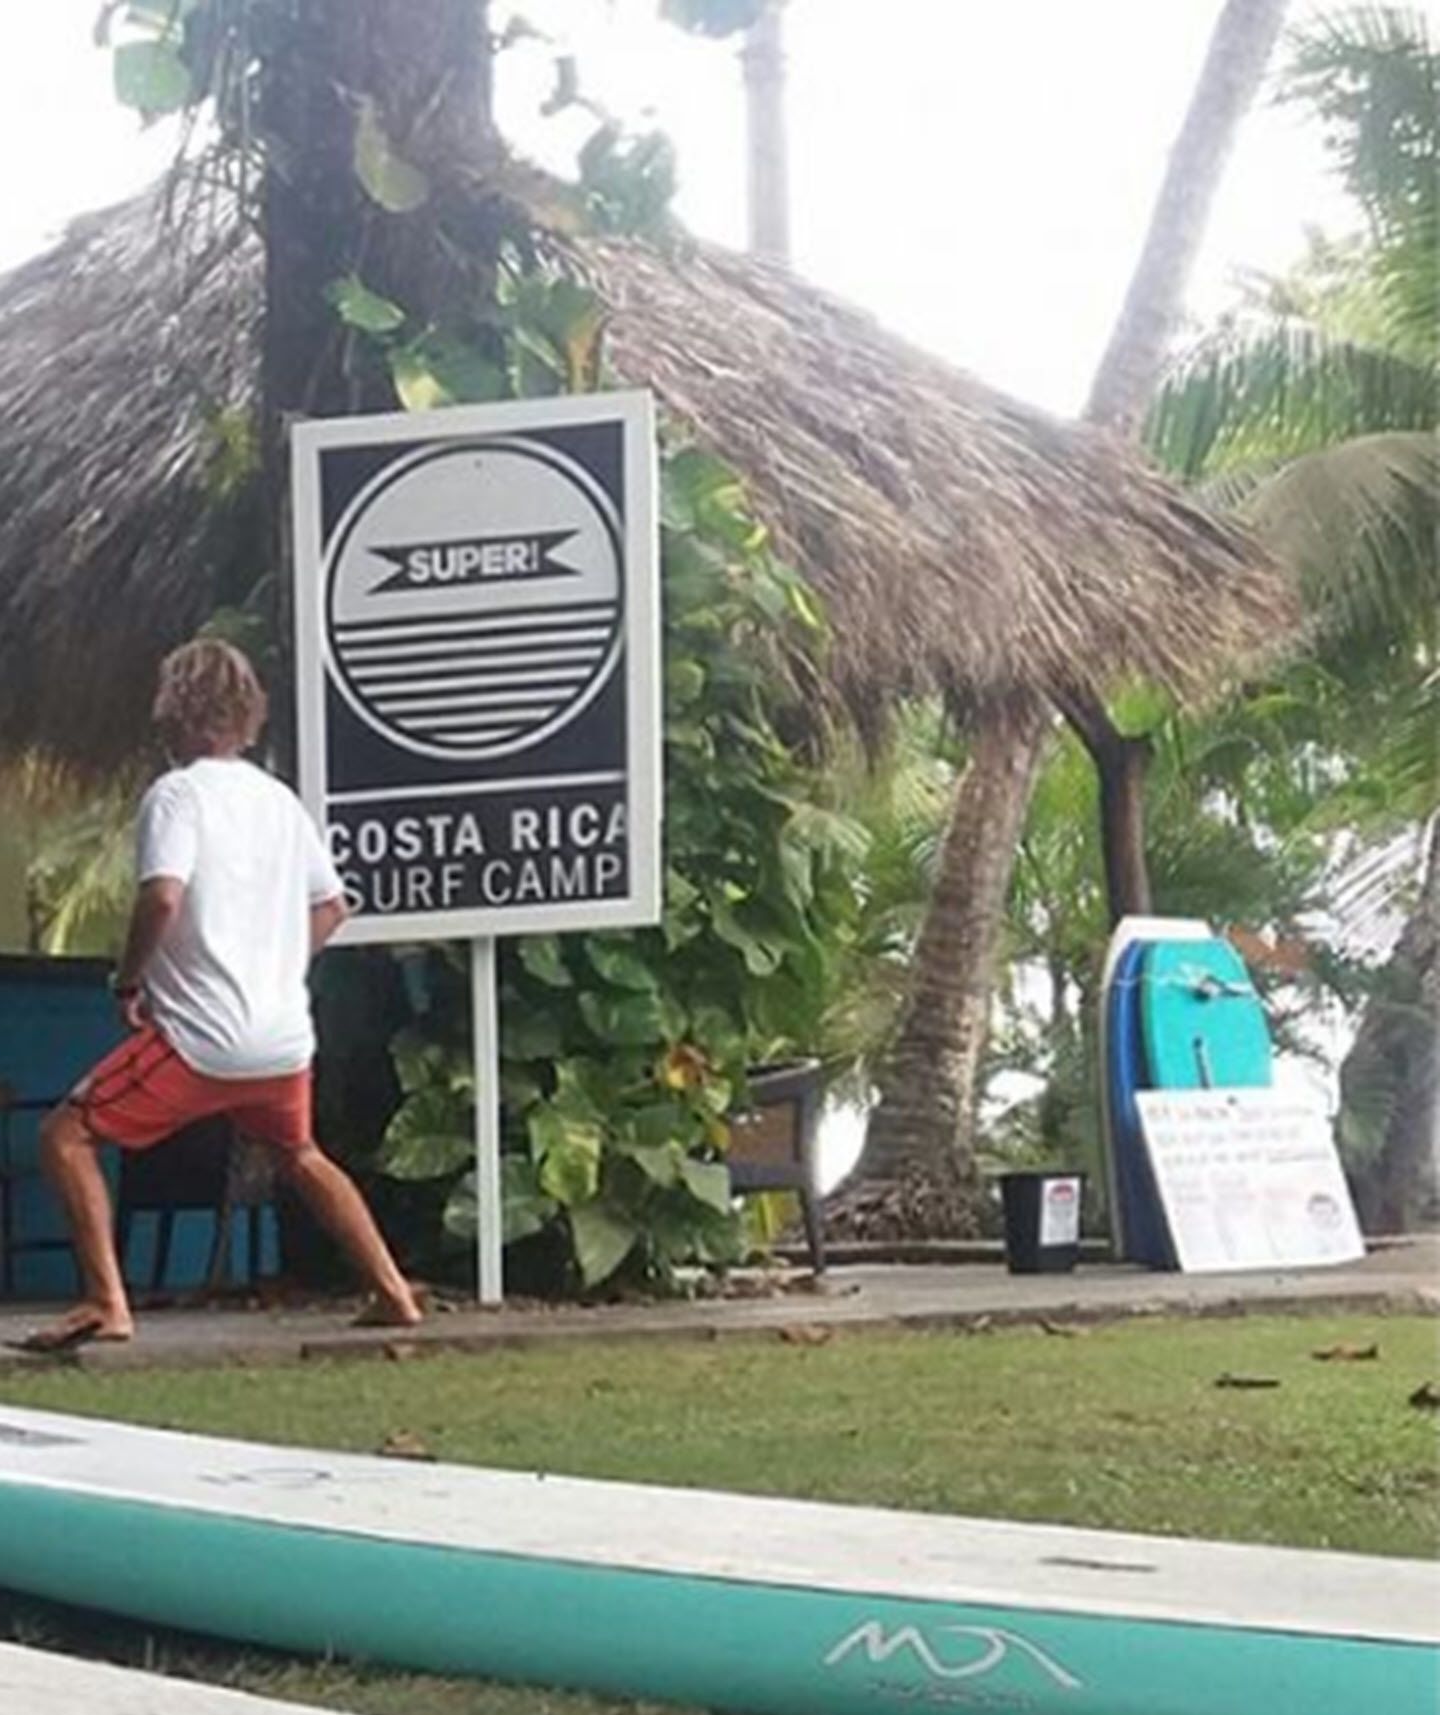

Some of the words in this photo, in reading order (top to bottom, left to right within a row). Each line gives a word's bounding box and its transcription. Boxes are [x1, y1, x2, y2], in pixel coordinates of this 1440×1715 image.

[408, 540, 539, 583] SUPER!
[326, 813, 485, 865] COSTA
[511, 803, 627, 851] RICA
[343, 863, 465, 914] SURF
[482, 853, 621, 904] CAMP
